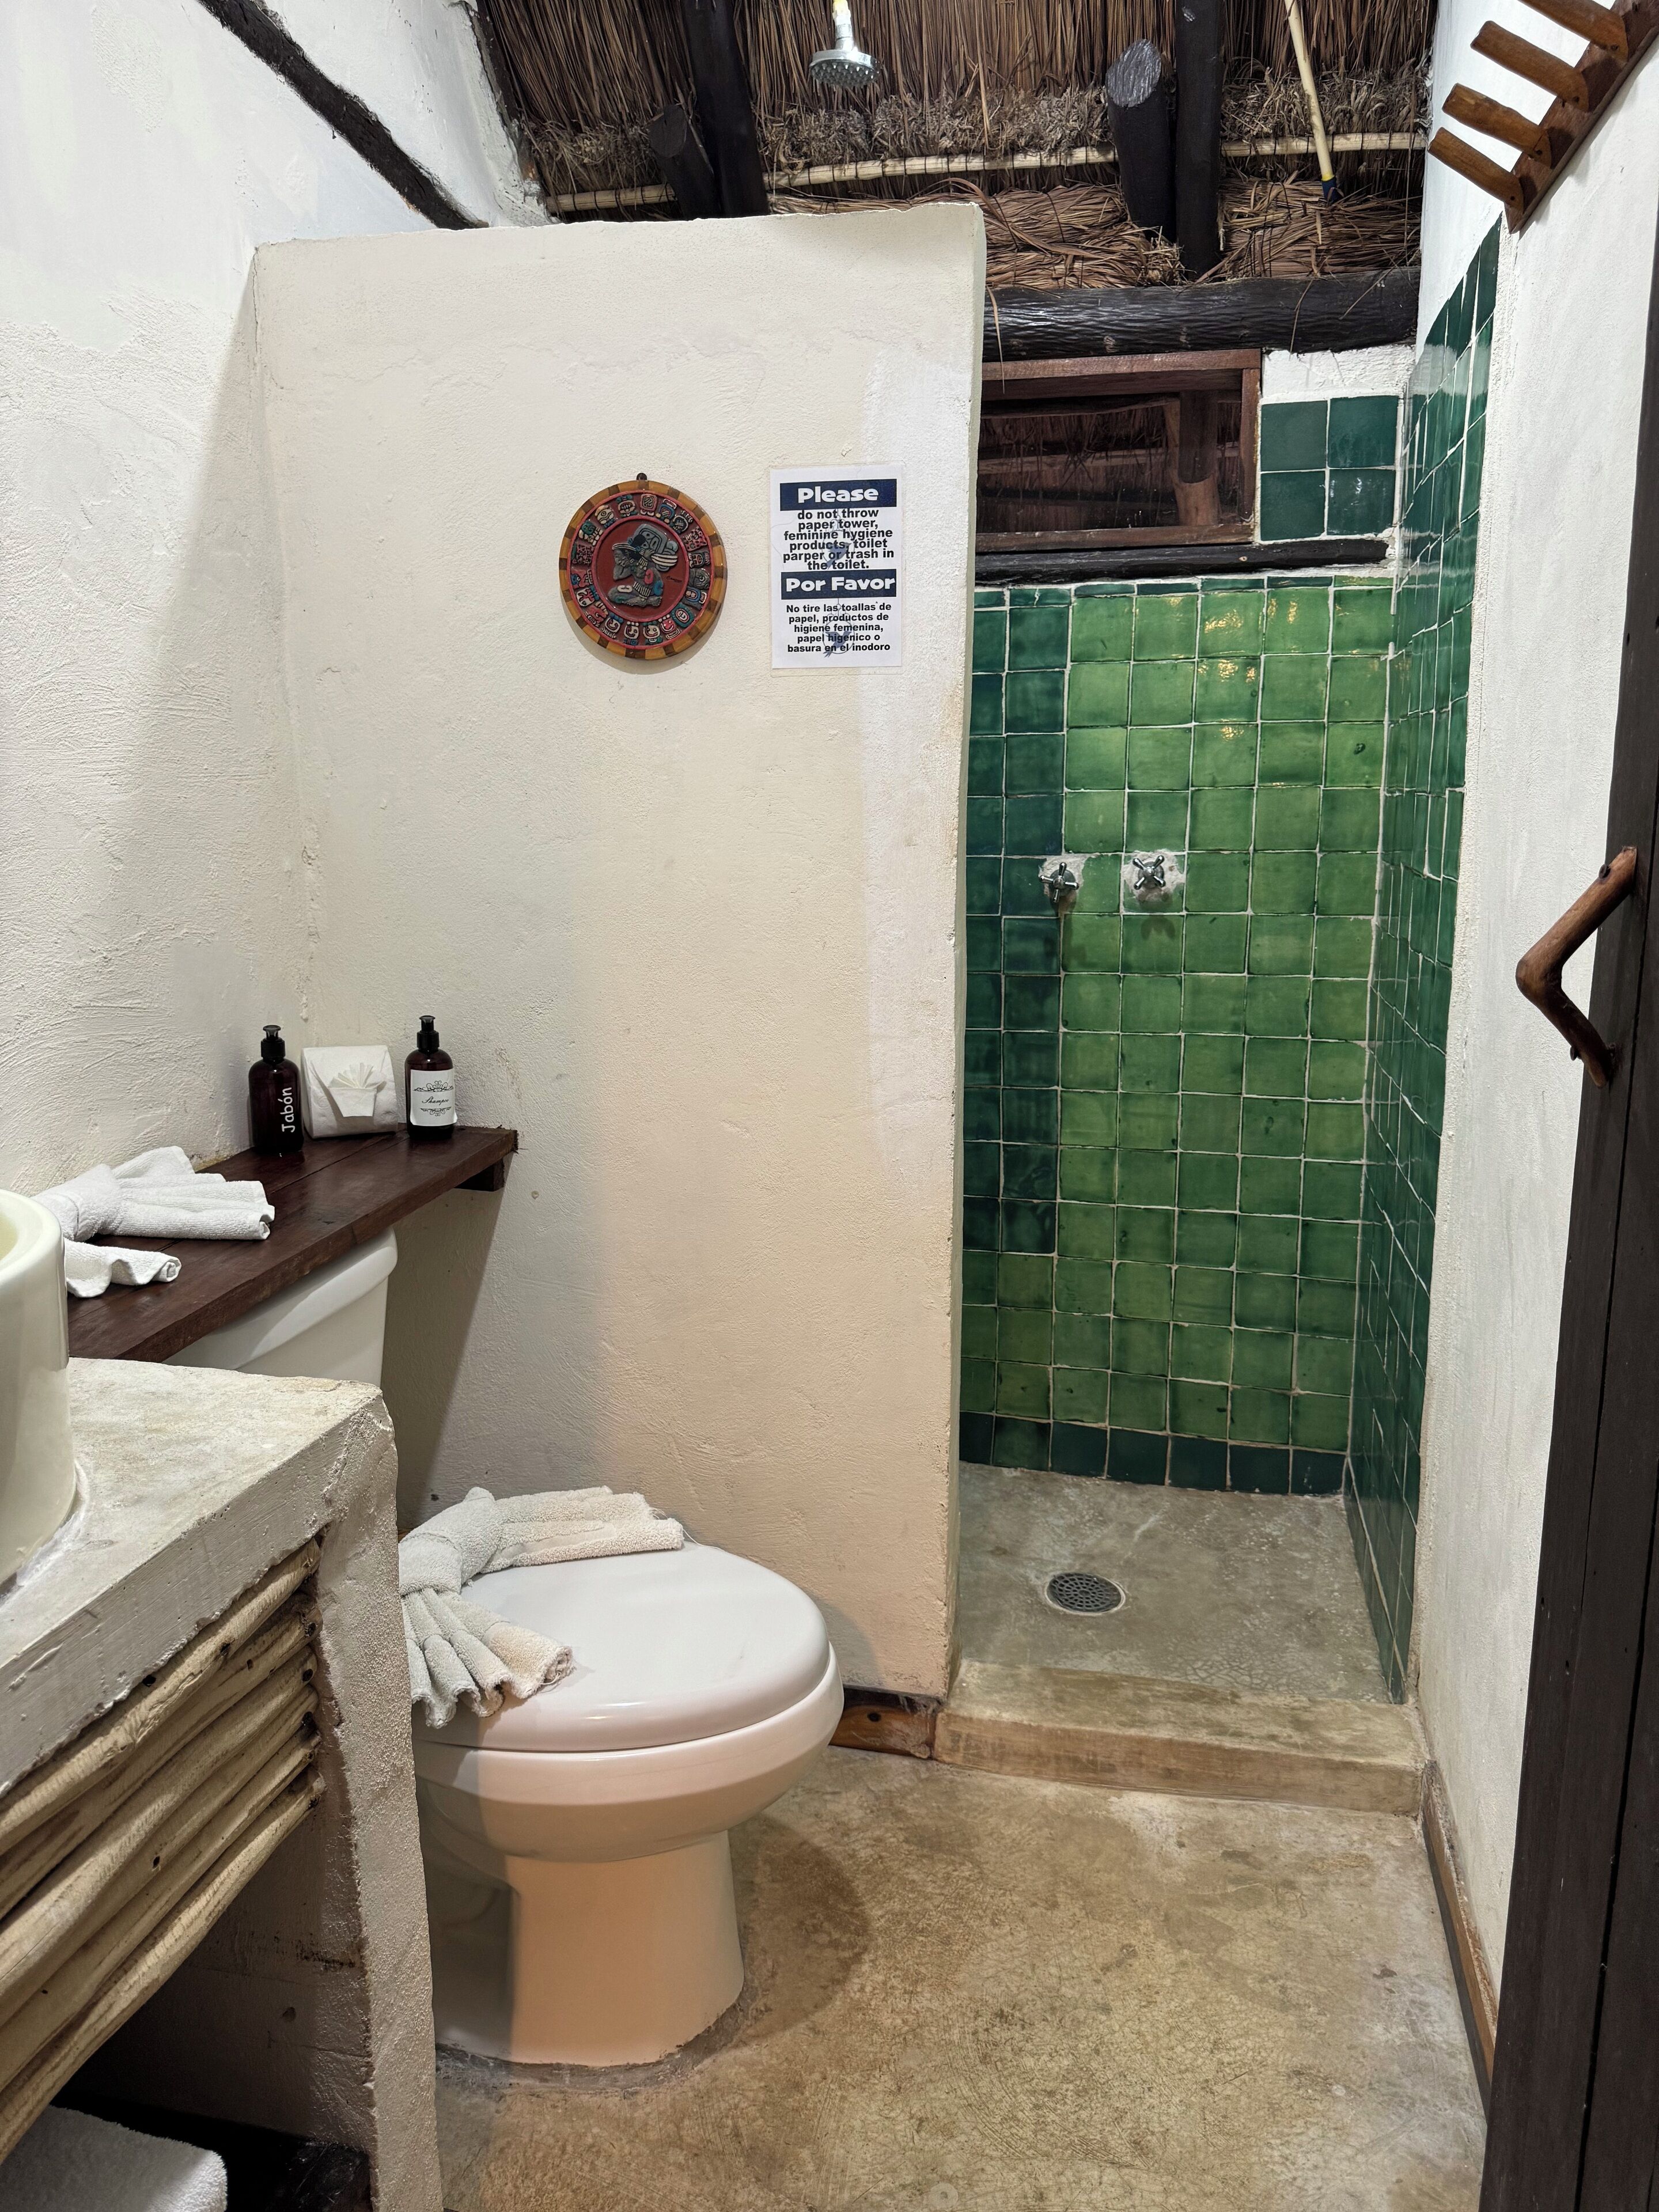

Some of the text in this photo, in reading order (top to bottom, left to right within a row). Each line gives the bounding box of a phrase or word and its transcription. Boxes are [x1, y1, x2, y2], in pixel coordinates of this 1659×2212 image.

[798, 486, 879, 503] Please
[797, 507, 879, 520] do not throw
[798, 519, 879, 532] paper tower,
[783, 529, 893, 541] feminine hygiene
[854, 537, 888, 548] toilet
[783, 547, 895, 563] parper or trash in
[807, 559, 870, 570] the toilet.
[786, 577, 895, 592] Por Favor
[786, 605, 800, 613] No
[823, 604, 838, 612] las
[842, 603, 876, 611] toallas
[879, 602, 892, 611] de
[789, 612, 889, 624] papel, productos de
[794, 623, 884, 634] higiene femenina,
[797, 634, 824, 644] papel
[828, 633, 871, 643] higenico
[787, 645, 821, 653] basura
[840, 643, 849, 652] el
[852, 642, 891, 652] inodoro
[277, 1087, 296, 1132] Jabón
